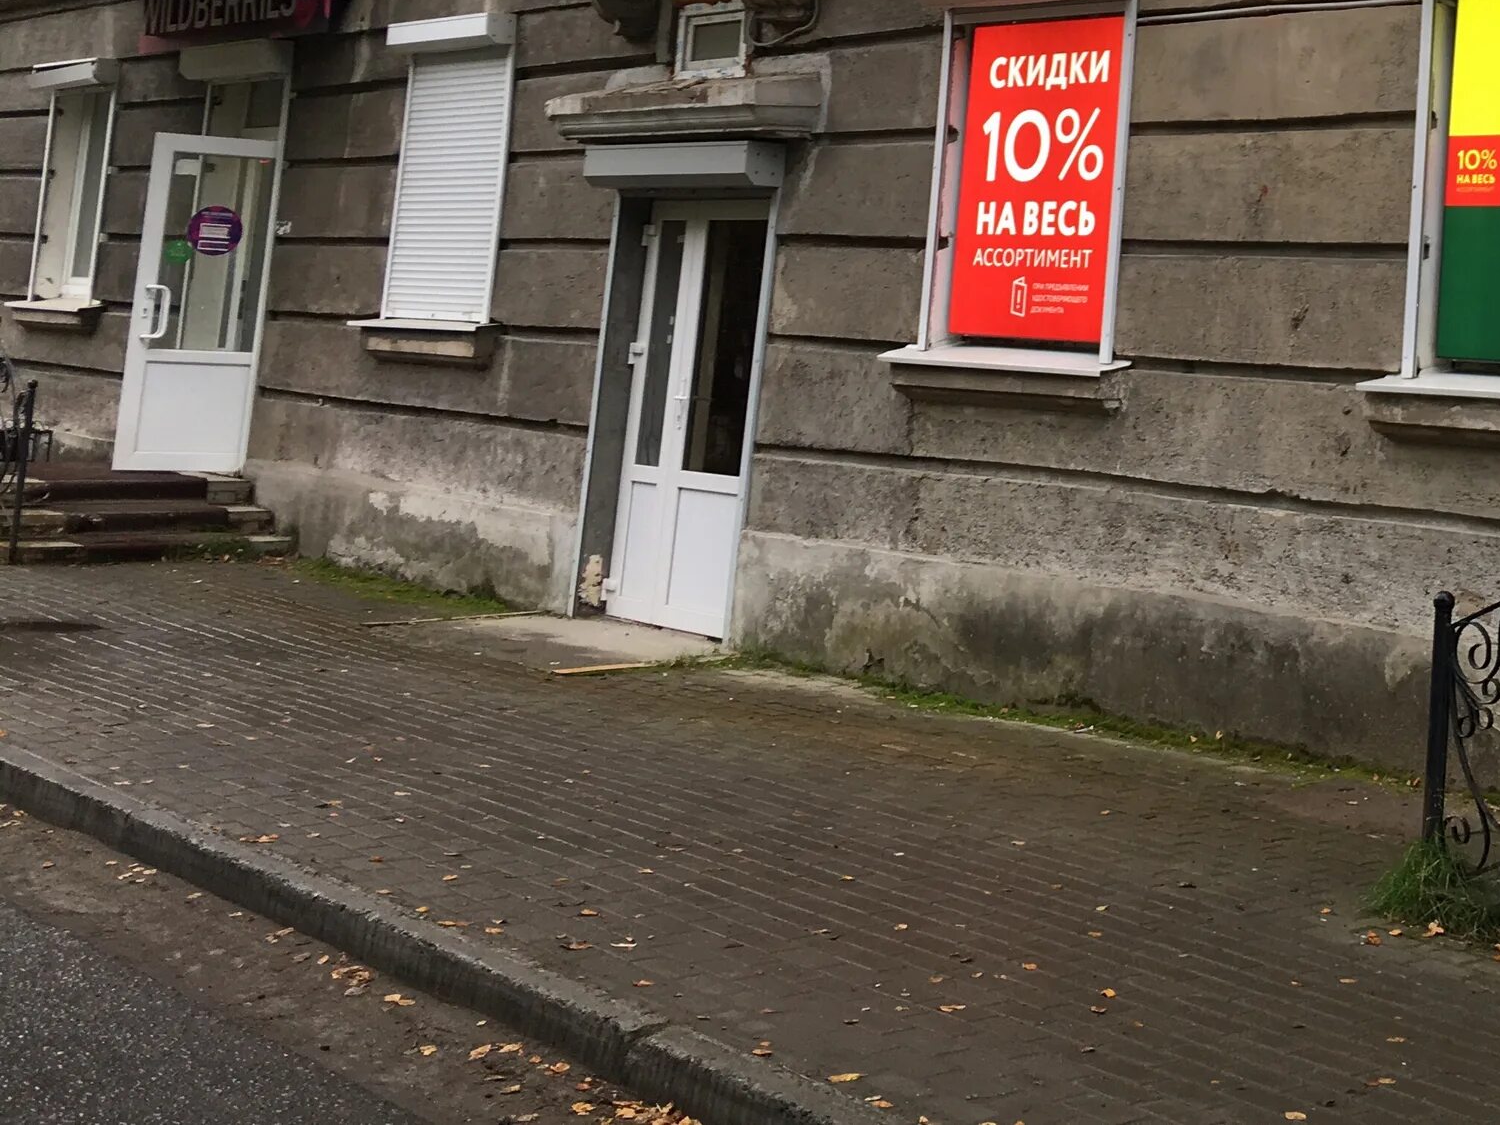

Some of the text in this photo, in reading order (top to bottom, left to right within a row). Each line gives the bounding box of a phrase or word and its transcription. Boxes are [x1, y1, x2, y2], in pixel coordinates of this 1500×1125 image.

[989, 49, 1111, 90] СКИДКИ
[983, 106, 1105, 182] 10%
[1457, 148, 1498, 170] 10%
[1456, 173, 1496, 184] НА ВЕСЬ
[976, 199, 1096, 237] НА ВЕСЬ
[973, 247, 1093, 269] АССОРТИМЕНТ
